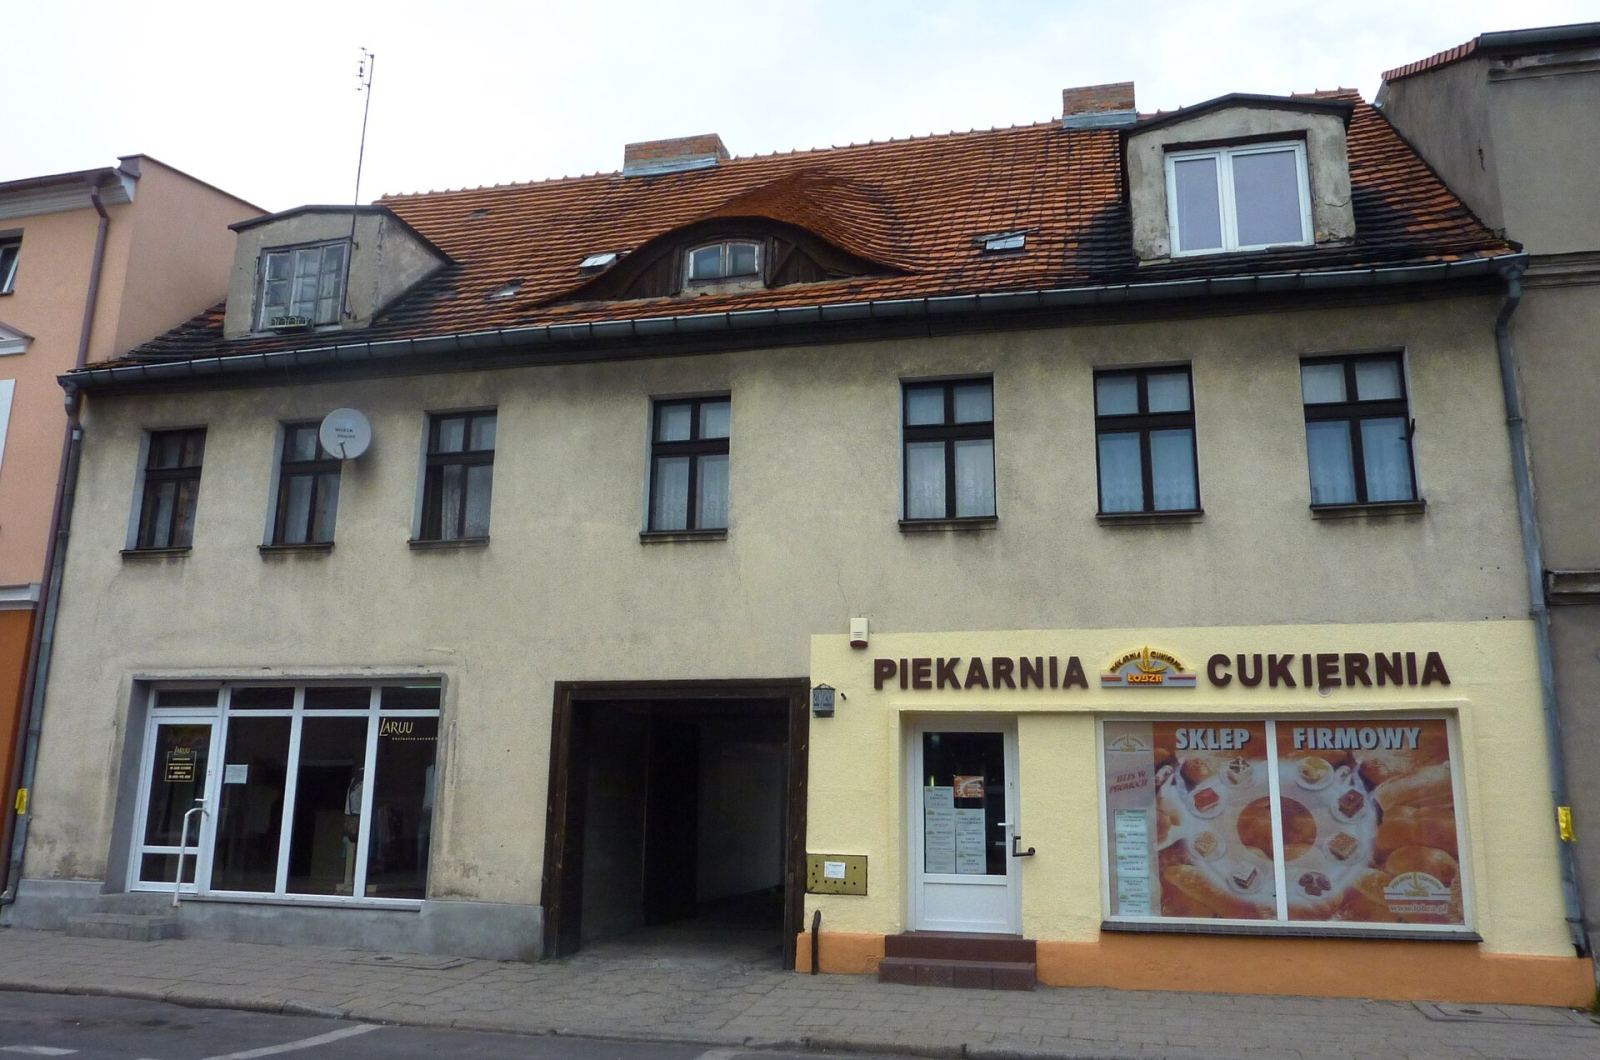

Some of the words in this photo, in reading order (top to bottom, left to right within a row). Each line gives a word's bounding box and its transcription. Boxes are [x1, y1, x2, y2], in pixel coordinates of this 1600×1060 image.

[873, 656, 1090, 690] PIEKARNIA
[1206, 651, 1452, 688] CUKIERNIA
[1175, 727, 1250, 750] SKLEP
[1292, 727, 1421, 751] FIRMOWY
